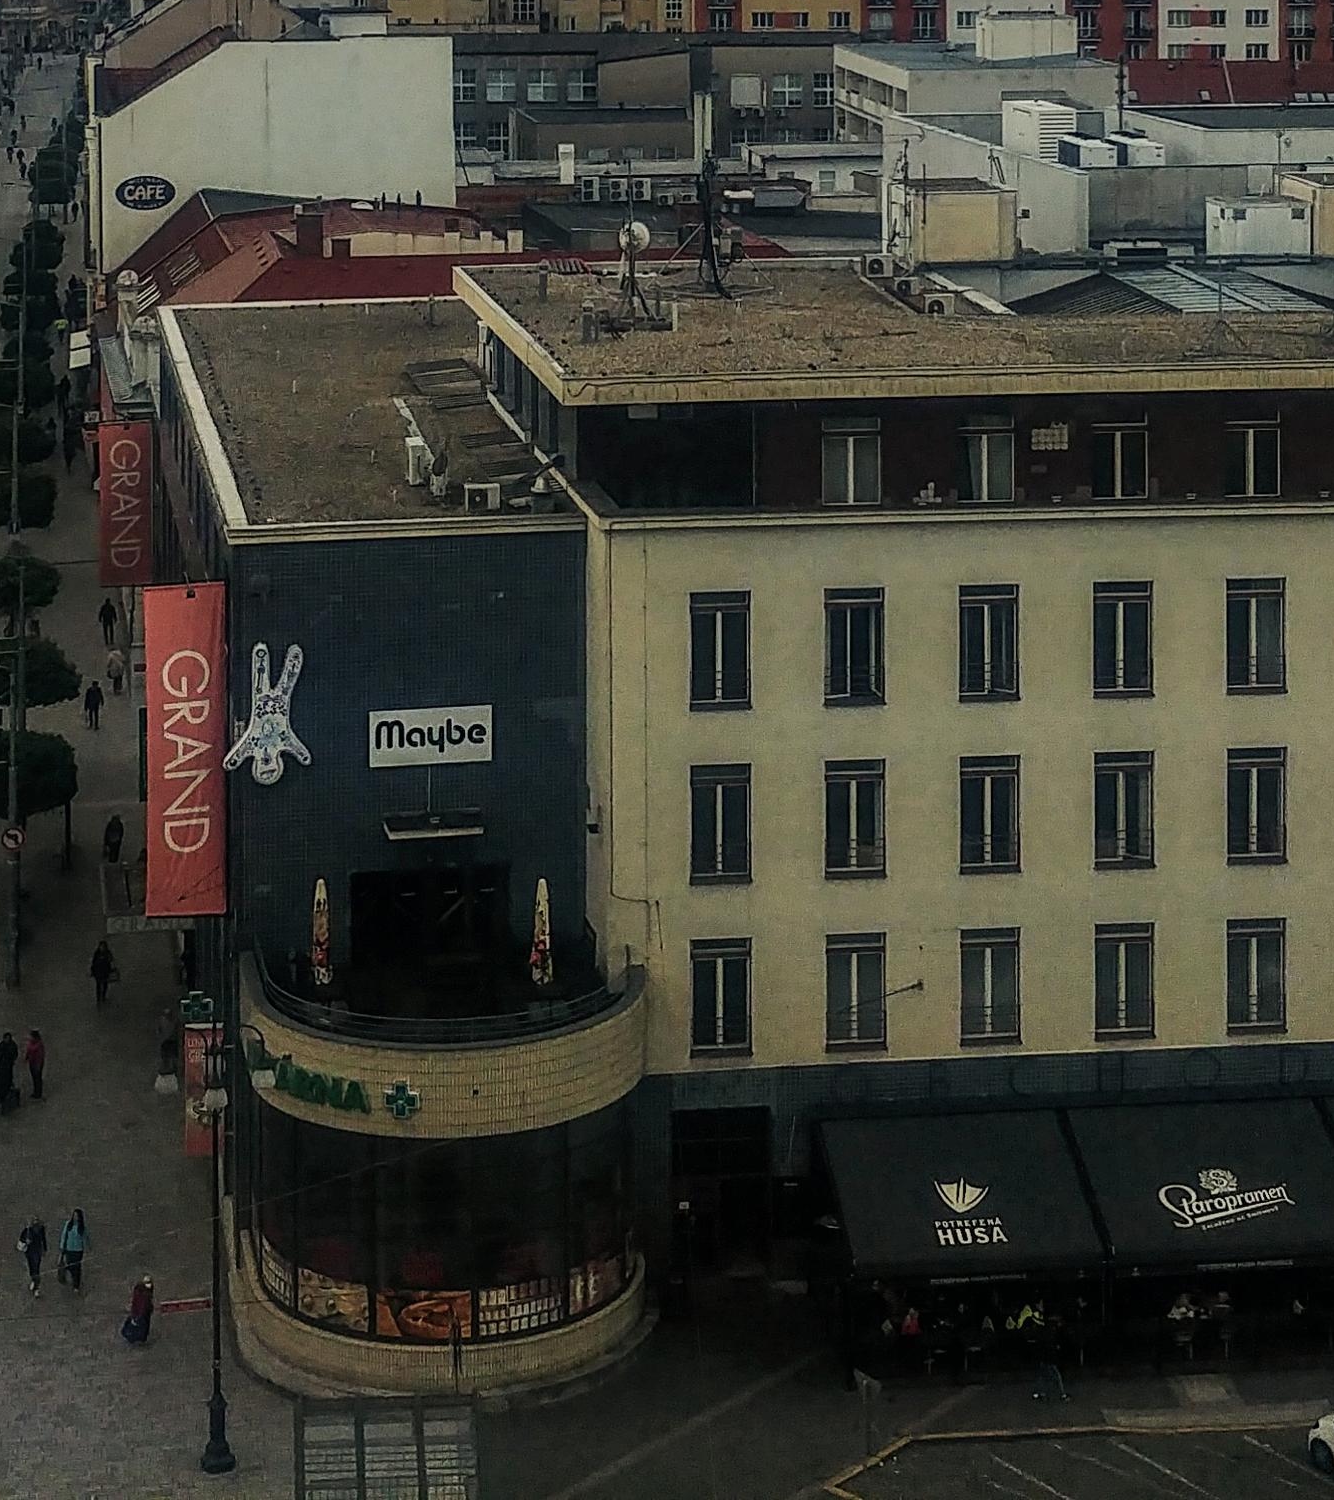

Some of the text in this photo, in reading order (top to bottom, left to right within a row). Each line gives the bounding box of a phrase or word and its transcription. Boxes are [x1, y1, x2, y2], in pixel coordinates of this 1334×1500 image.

[110, 439, 142, 569] GRAND
[162, 650, 212, 853] GRAND
[375, 719, 488, 752] Maybe
[1158, 1182, 1296, 1228] Staropramen
[937, 1226, 1009, 1246] HUSA
